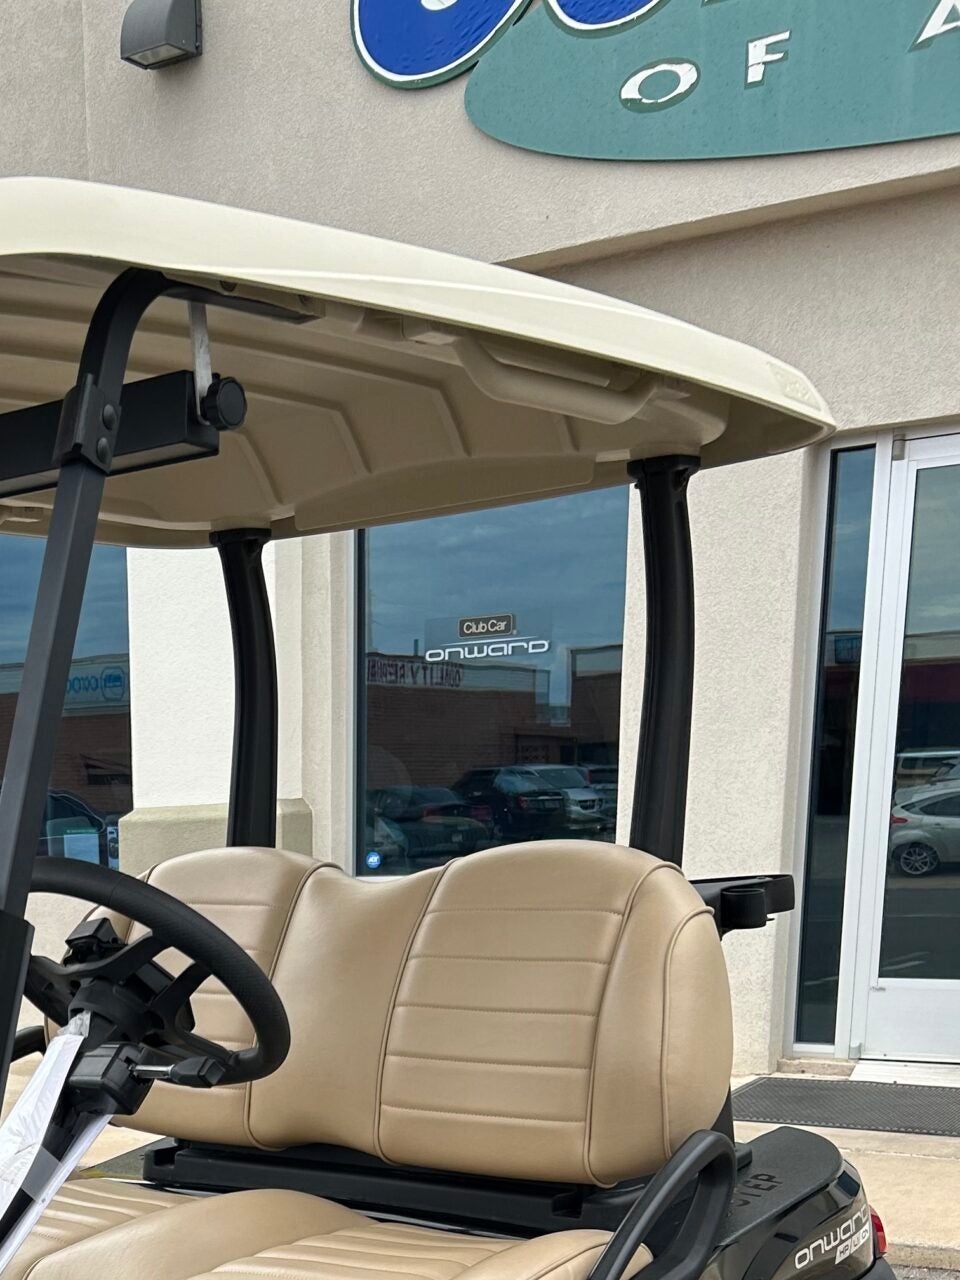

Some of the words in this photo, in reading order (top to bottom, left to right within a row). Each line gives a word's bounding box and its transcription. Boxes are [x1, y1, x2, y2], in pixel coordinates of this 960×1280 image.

[620, 30, 791, 104] OF
[463, 622, 487, 634] Club
[488, 619, 507, 632] Car
